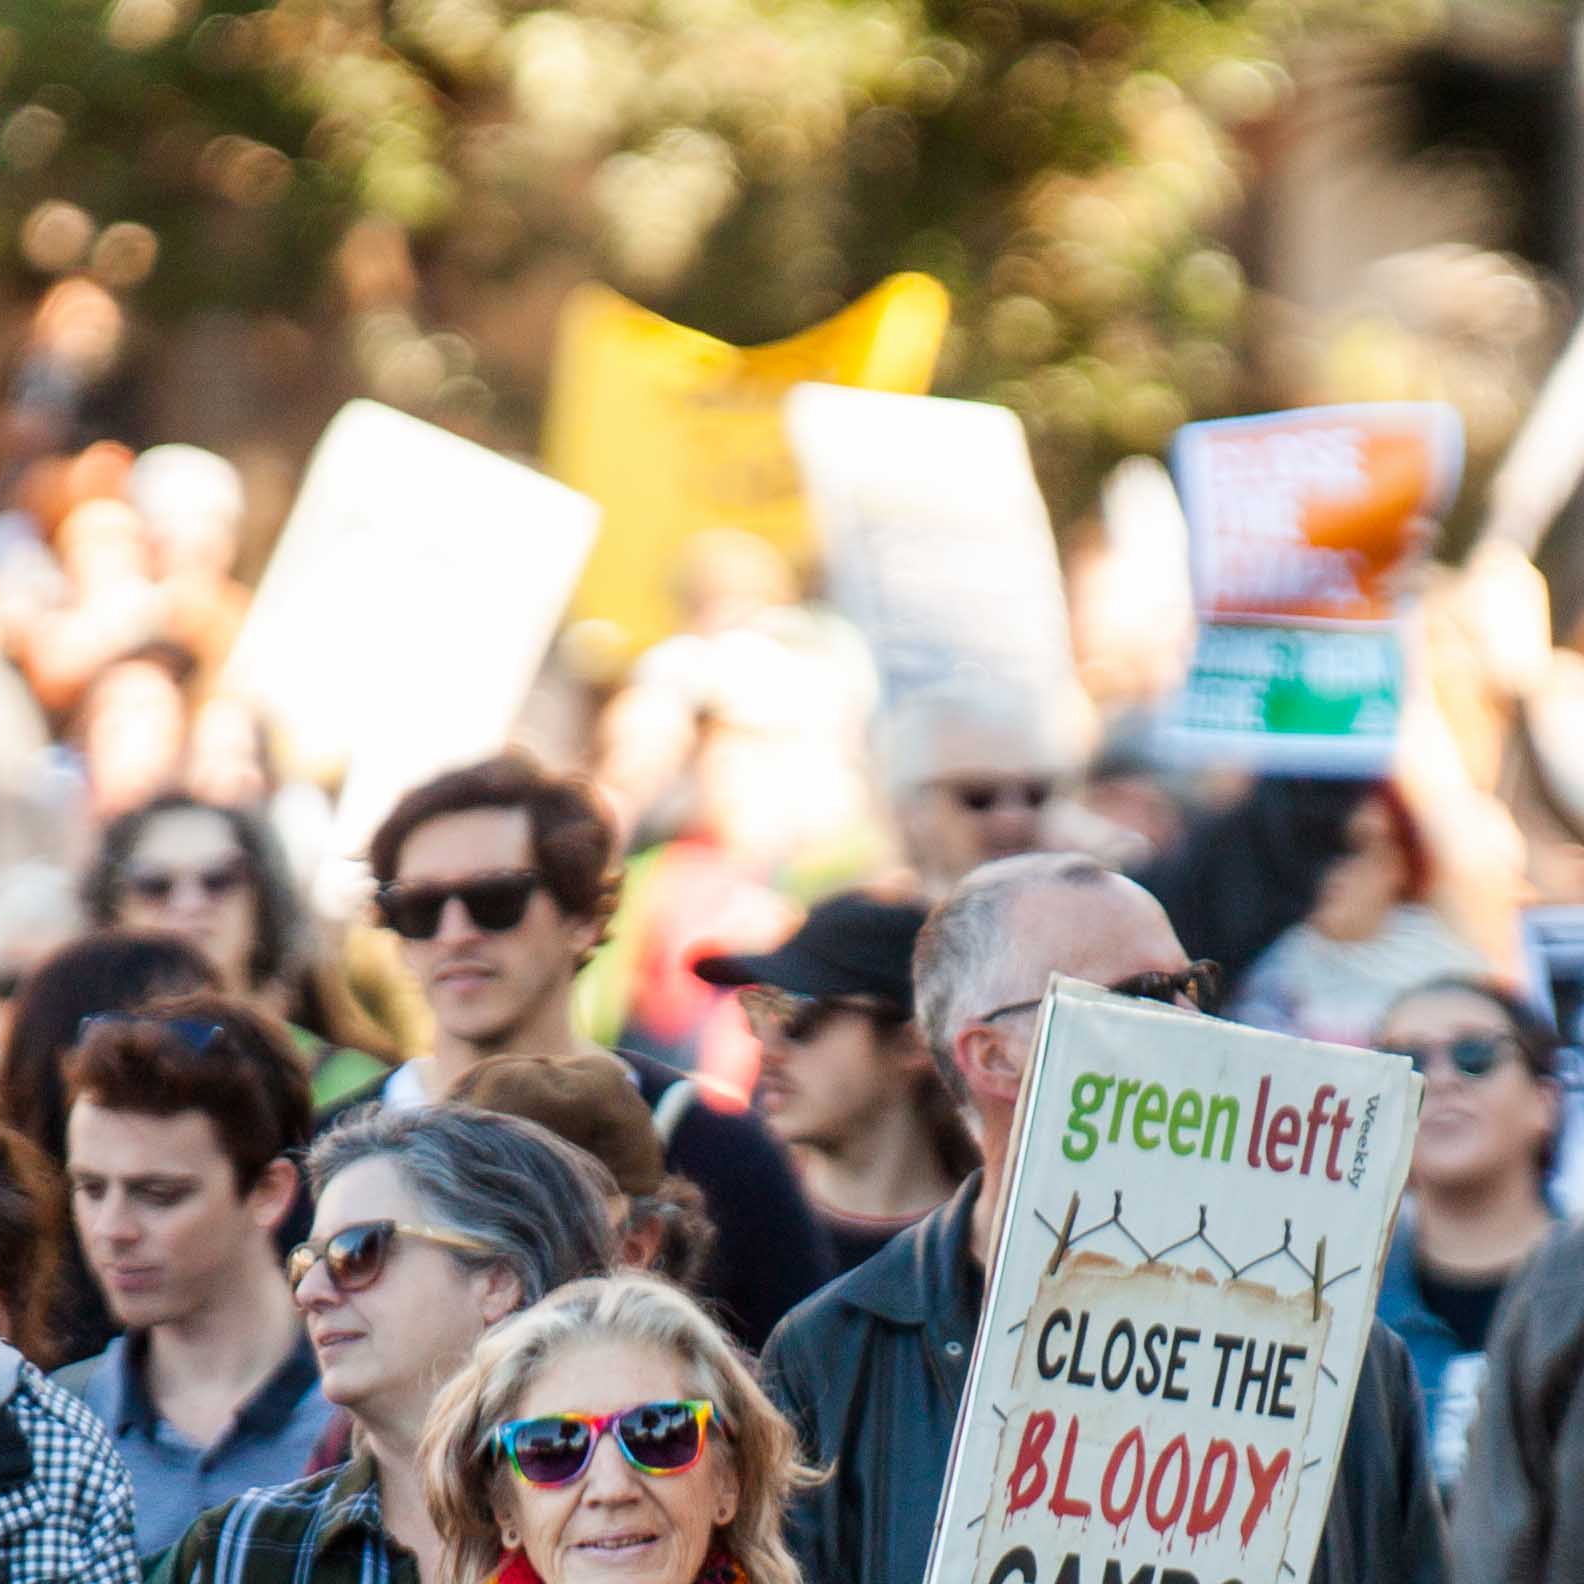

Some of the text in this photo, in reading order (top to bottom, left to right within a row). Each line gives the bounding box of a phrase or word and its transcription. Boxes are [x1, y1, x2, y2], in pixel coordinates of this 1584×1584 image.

[1061, 1071, 1355, 1183] green left
[1037, 1306, 1308, 1420] CLOSE THE
[1002, 1409, 1292, 1556] BLOODY
